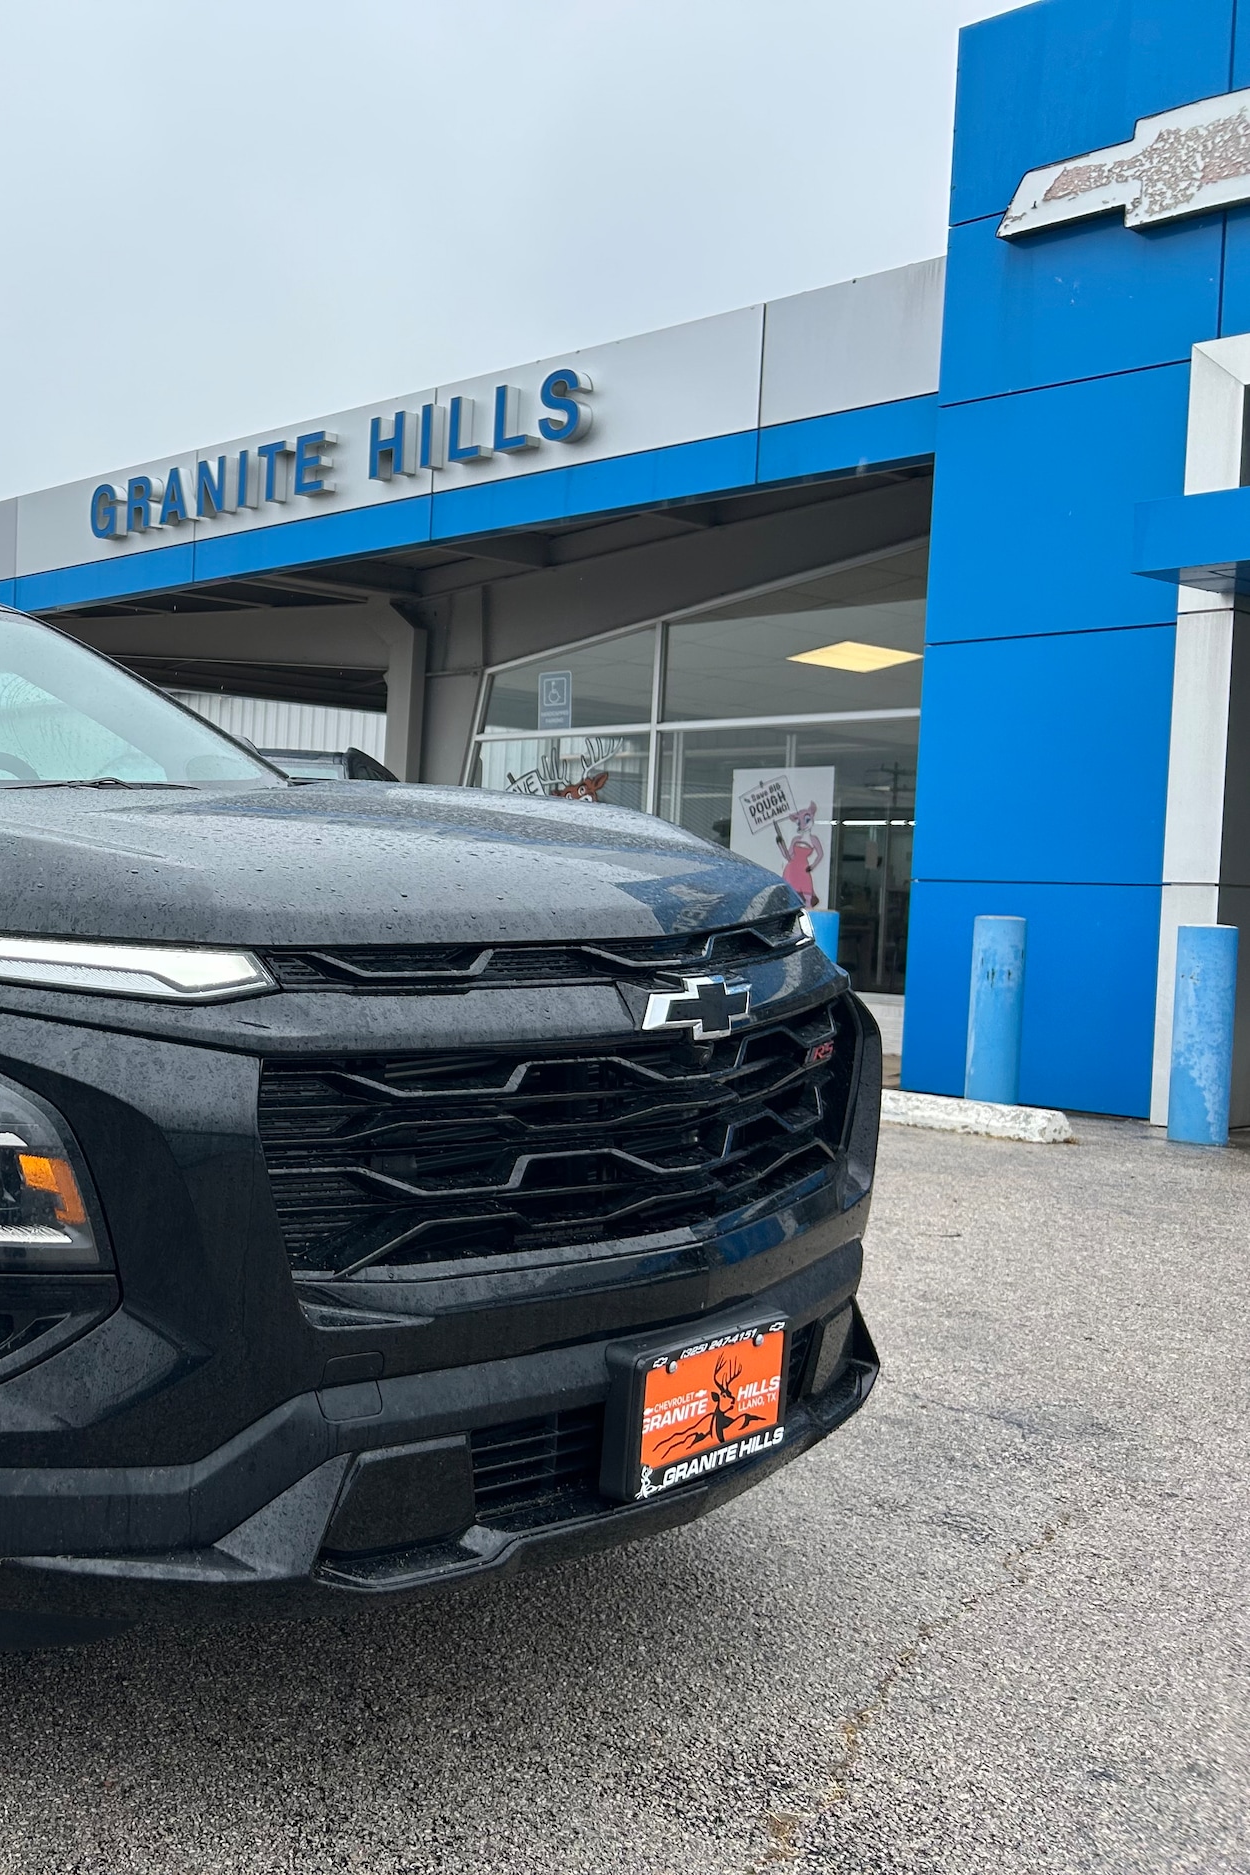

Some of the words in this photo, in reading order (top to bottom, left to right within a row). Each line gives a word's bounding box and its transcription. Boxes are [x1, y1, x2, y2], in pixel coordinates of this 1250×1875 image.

[90, 430, 338, 541] GRANITE
[368, 368, 594, 482] HILLS
[748, 790, 787, 818] DOUGH
[680, 1343, 707, 1360] (325)
[642, 1397, 709, 1435] GRANITE
[736, 1375, 781, 1401] HILLS
[653, 1391, 695, 1412] CHEVROLET
[737, 1396, 765, 1412] LLANO,
[766, 1391, 777, 1403] TX
[662, 1442, 739, 1487] GRANITE
[738, 1426, 785, 1459] HILLS
